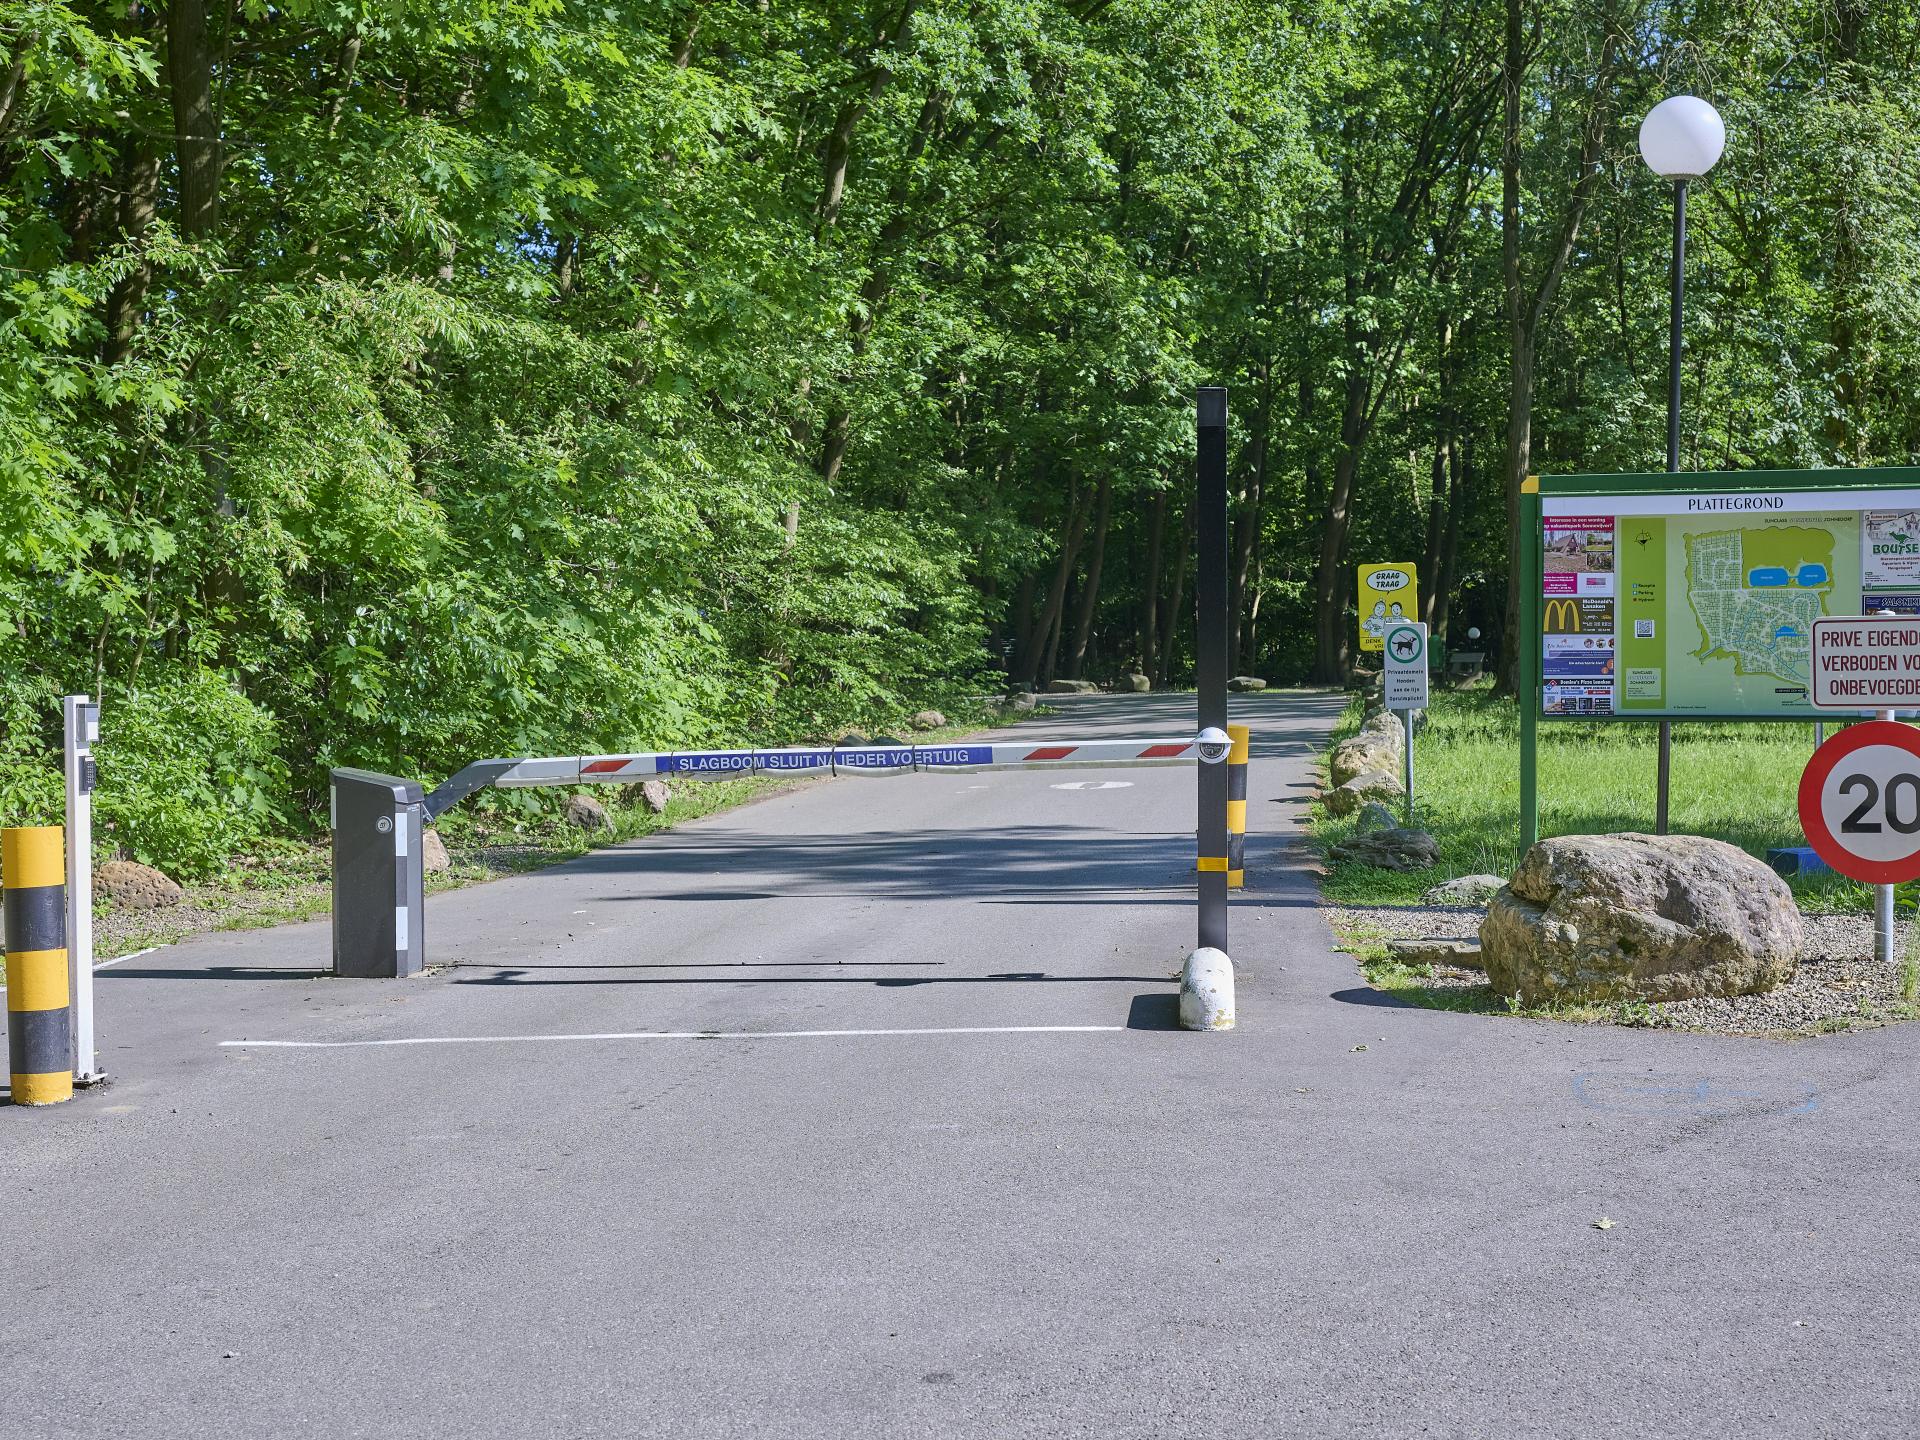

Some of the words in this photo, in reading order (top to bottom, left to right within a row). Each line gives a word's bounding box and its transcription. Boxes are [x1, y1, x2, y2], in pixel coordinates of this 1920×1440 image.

[1688, 497, 1784, 510] PLATTEGROND
[1376, 572, 1400, 580] GRAAG
[1376, 580, 1400, 588] TRAAG
[1821, 631, 1863, 648] PRIVE
[1867, 629, 1920, 647] EIGEND
[1821, 654, 1897, 672] VERBODEN
[679, 756, 766, 771] SLAGBOOM
[769, 755, 813, 769] SLUIT
[841, 753, 887, 766] IEDER
[890, 749, 970, 765] VOERTUIG
[1838, 773, 1920, 835] 20
